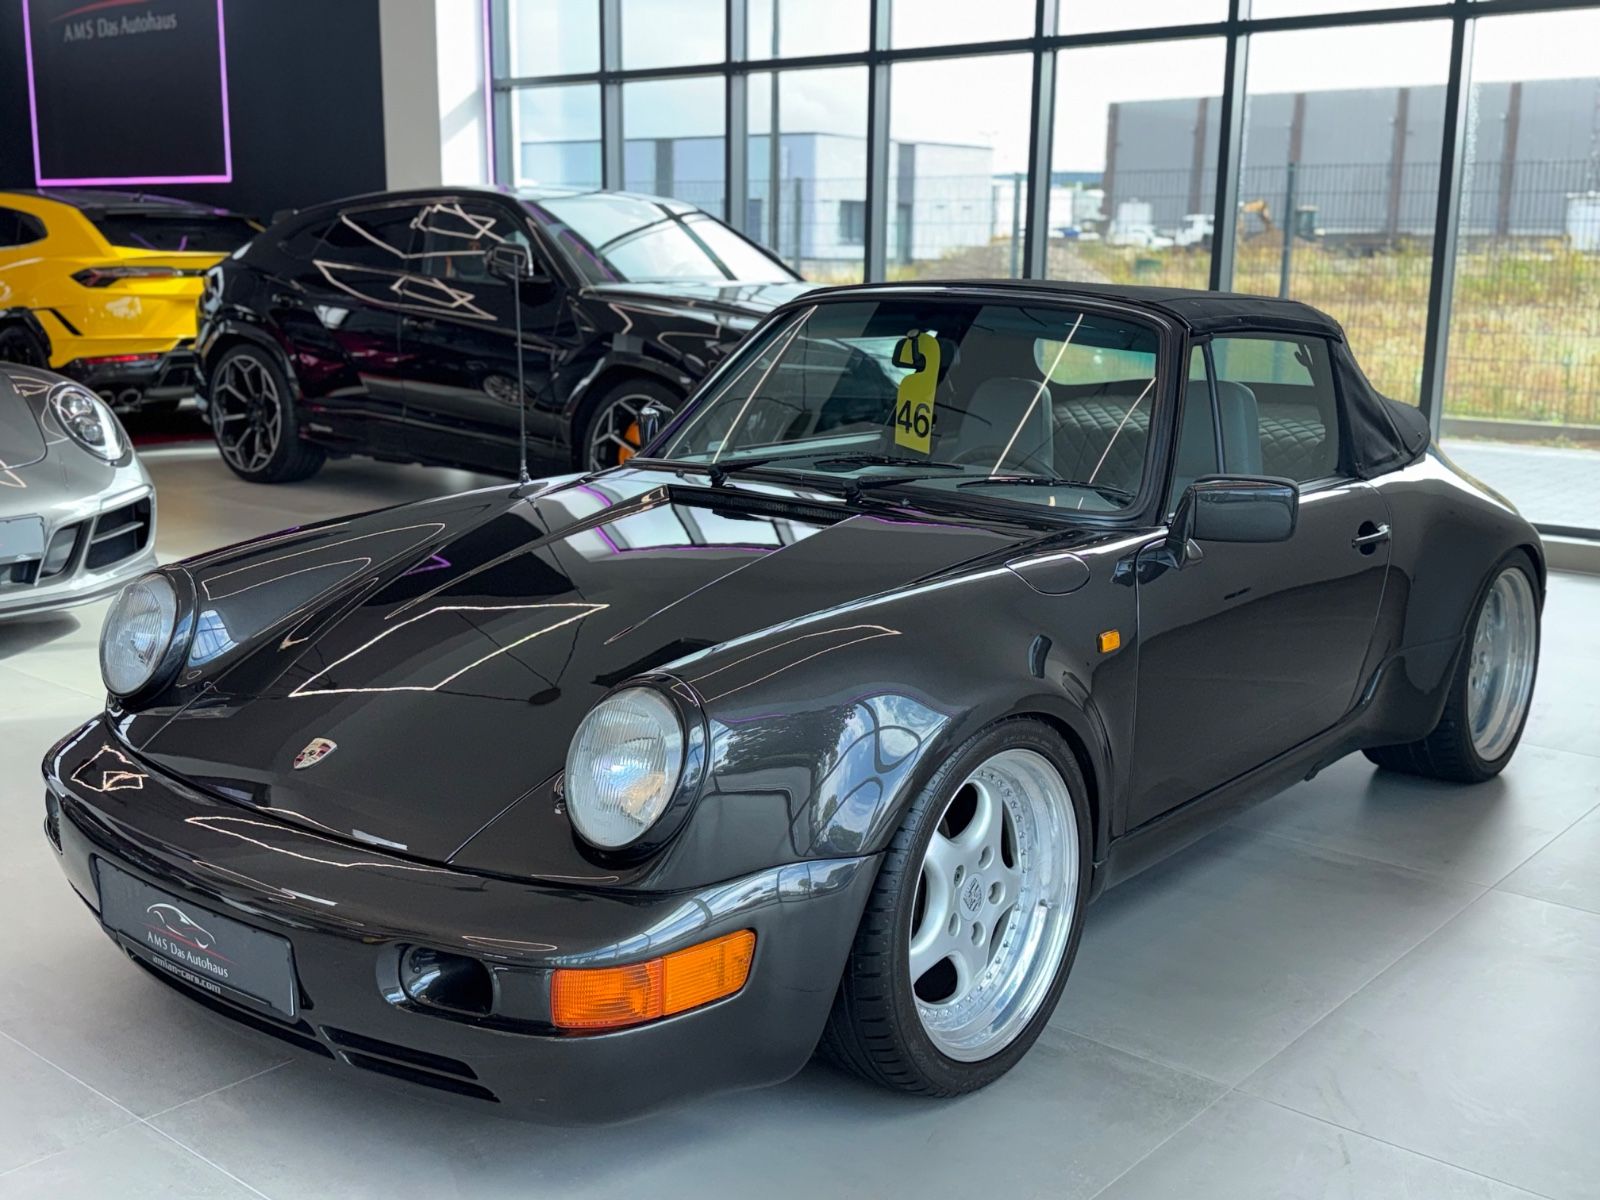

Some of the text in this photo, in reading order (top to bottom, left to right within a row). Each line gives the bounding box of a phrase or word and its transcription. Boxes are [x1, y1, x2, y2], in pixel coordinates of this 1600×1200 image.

[64, 10, 177, 42] AMS Das Autohaus
[897, 400, 931, 438] 46
[147, 931, 229, 978] AMS Das Autohaus
